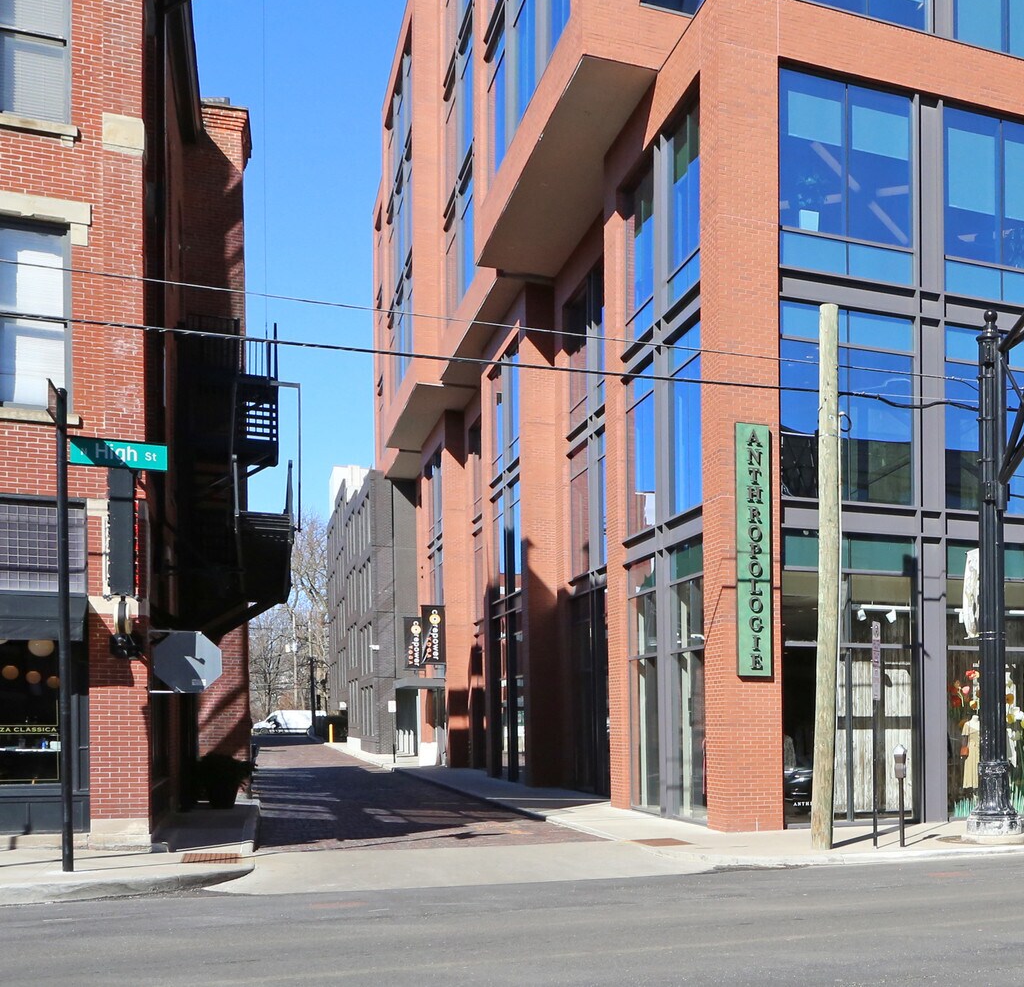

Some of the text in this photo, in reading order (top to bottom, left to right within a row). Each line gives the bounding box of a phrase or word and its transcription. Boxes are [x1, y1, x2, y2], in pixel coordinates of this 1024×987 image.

[95, 442, 138, 466] High
[144, 451, 157, 462] St
[748, 429, 764, 670] ANTHROPOLOGIE
